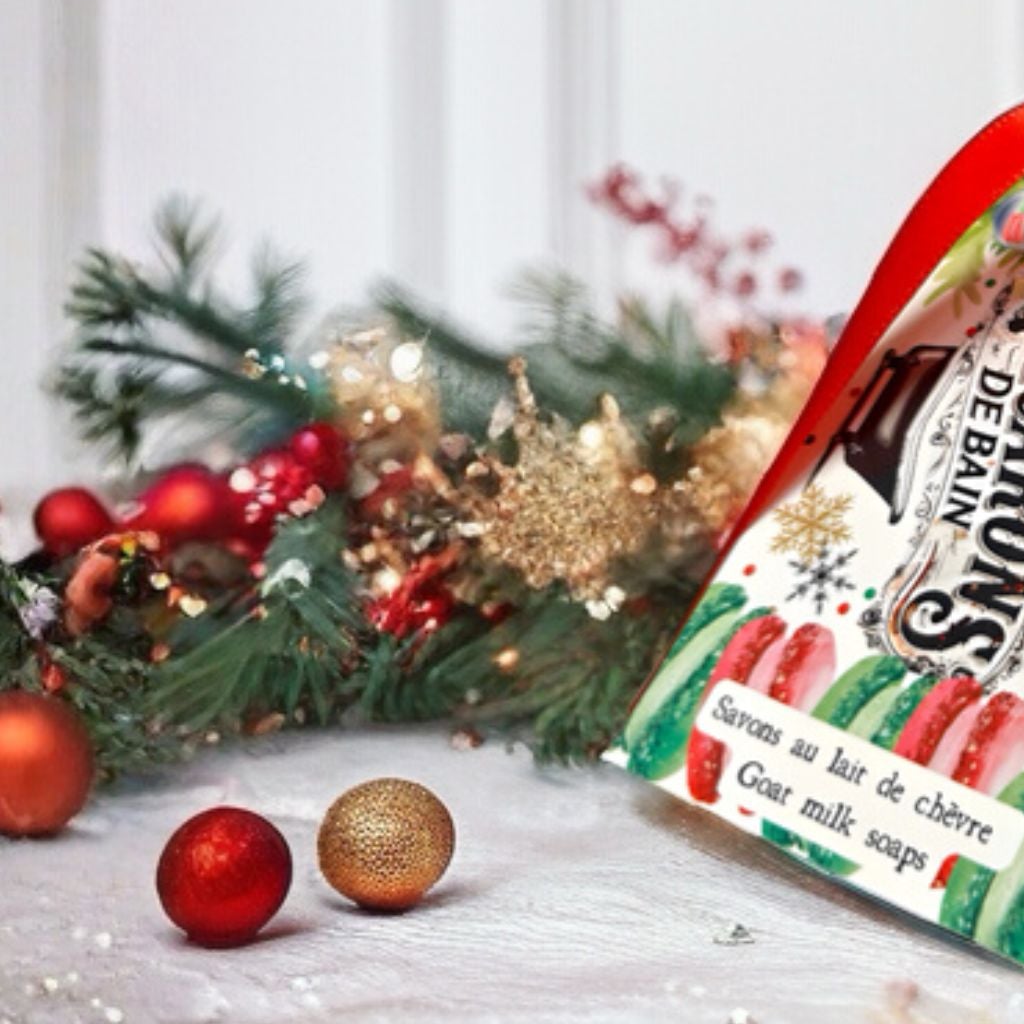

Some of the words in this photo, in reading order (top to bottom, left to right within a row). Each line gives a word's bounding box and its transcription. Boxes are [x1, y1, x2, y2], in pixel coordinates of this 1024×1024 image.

[970, 365, 1015, 425] DE
[941, 427, 999, 529] BAIN
[711, 693, 784, 746] Savons
[790, 737, 820, 763] au
[826, 746, 868, 786] lait
[876, 771, 906, 804] de
[914, 791, 994, 845] chèvre
[736, 760, 794, 806] Goat
[799, 796, 857, 837] milk
[864, 828, 930, 873] soaps
